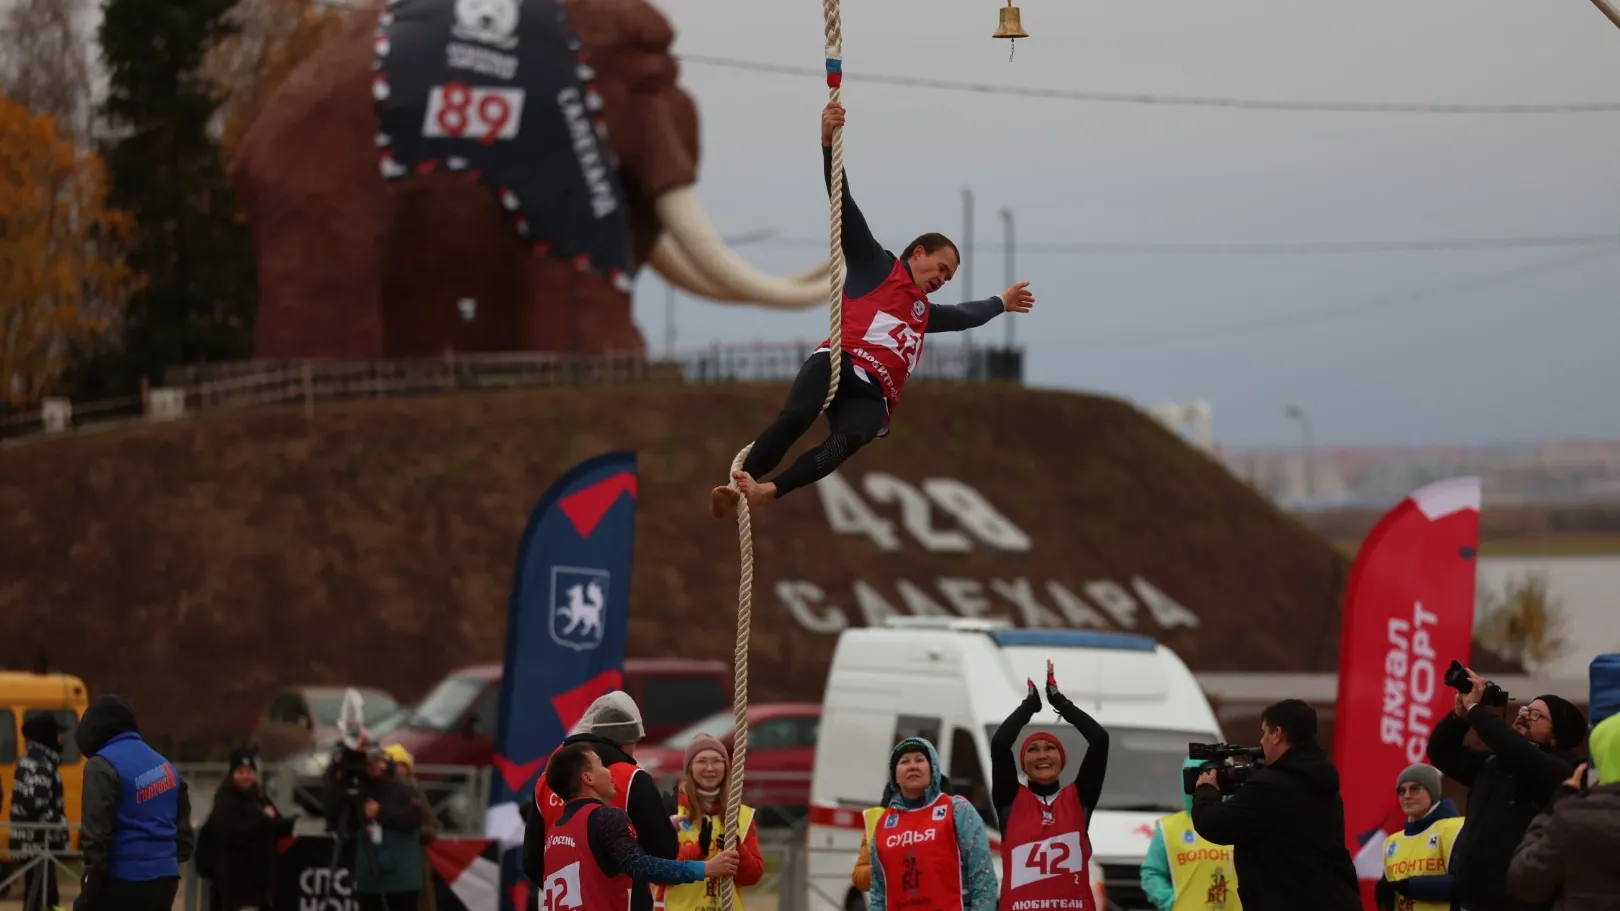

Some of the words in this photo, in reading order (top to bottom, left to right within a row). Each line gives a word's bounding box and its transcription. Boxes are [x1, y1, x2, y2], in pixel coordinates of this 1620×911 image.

[437, 82, 510, 145] 89
[815, 471, 1032, 551] 428
[1405, 600, 1439, 765] СПОРТ
[552, 835, 576, 848] ОСЕНЬ
[886, 828, 936, 848] СУДЬЯ
[1025, 843, 1071, 875] 42
[1177, 848, 1231, 867] ВОЛОН
[1387, 856, 1446, 876] ЛОНТЕР
[1012, 899, 1083, 911] ЛЮБИТЕЛИ
